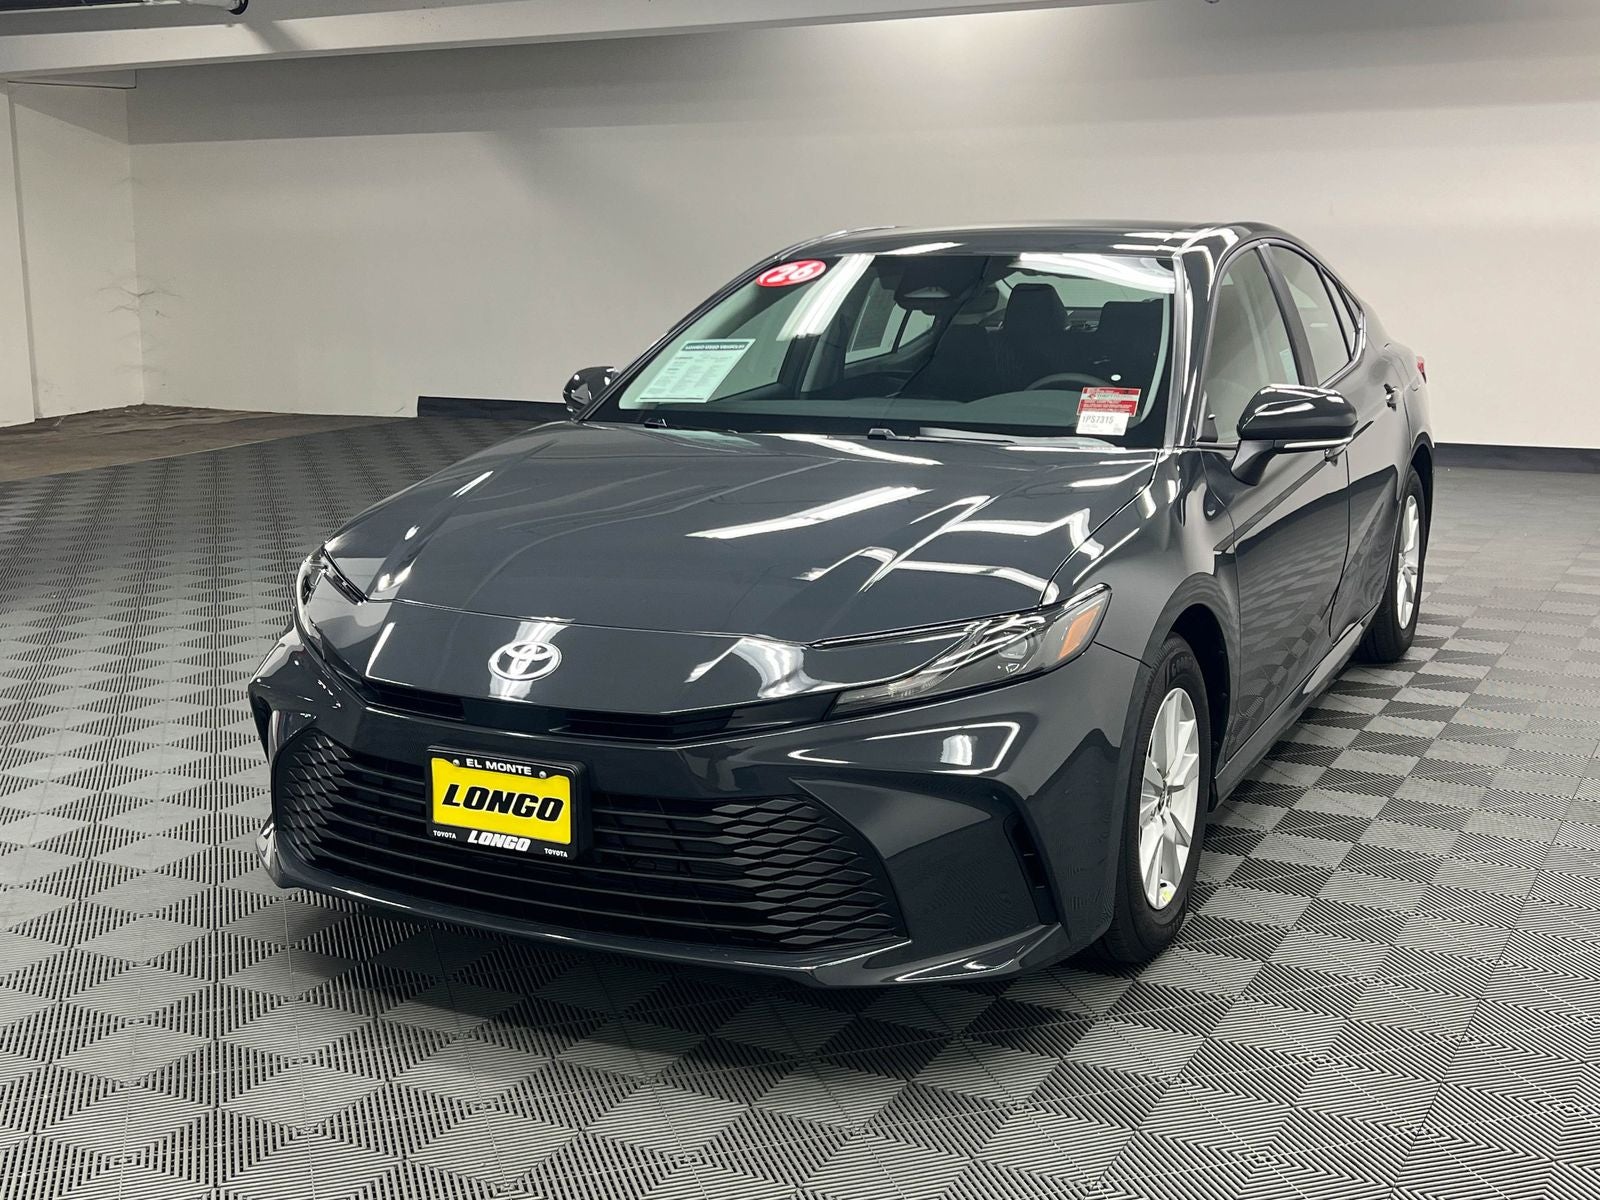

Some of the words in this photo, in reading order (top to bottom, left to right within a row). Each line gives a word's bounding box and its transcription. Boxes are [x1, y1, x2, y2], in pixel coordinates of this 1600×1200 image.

[465, 758, 482, 768] EL
[485, 760, 532, 776] MONTE
[442, 783, 564, 822] LONGO
[432, 829, 457, 840] TOYOTA
[467, 830, 532, 852] LONGO
[544, 847, 569, 858] TOYOTA
